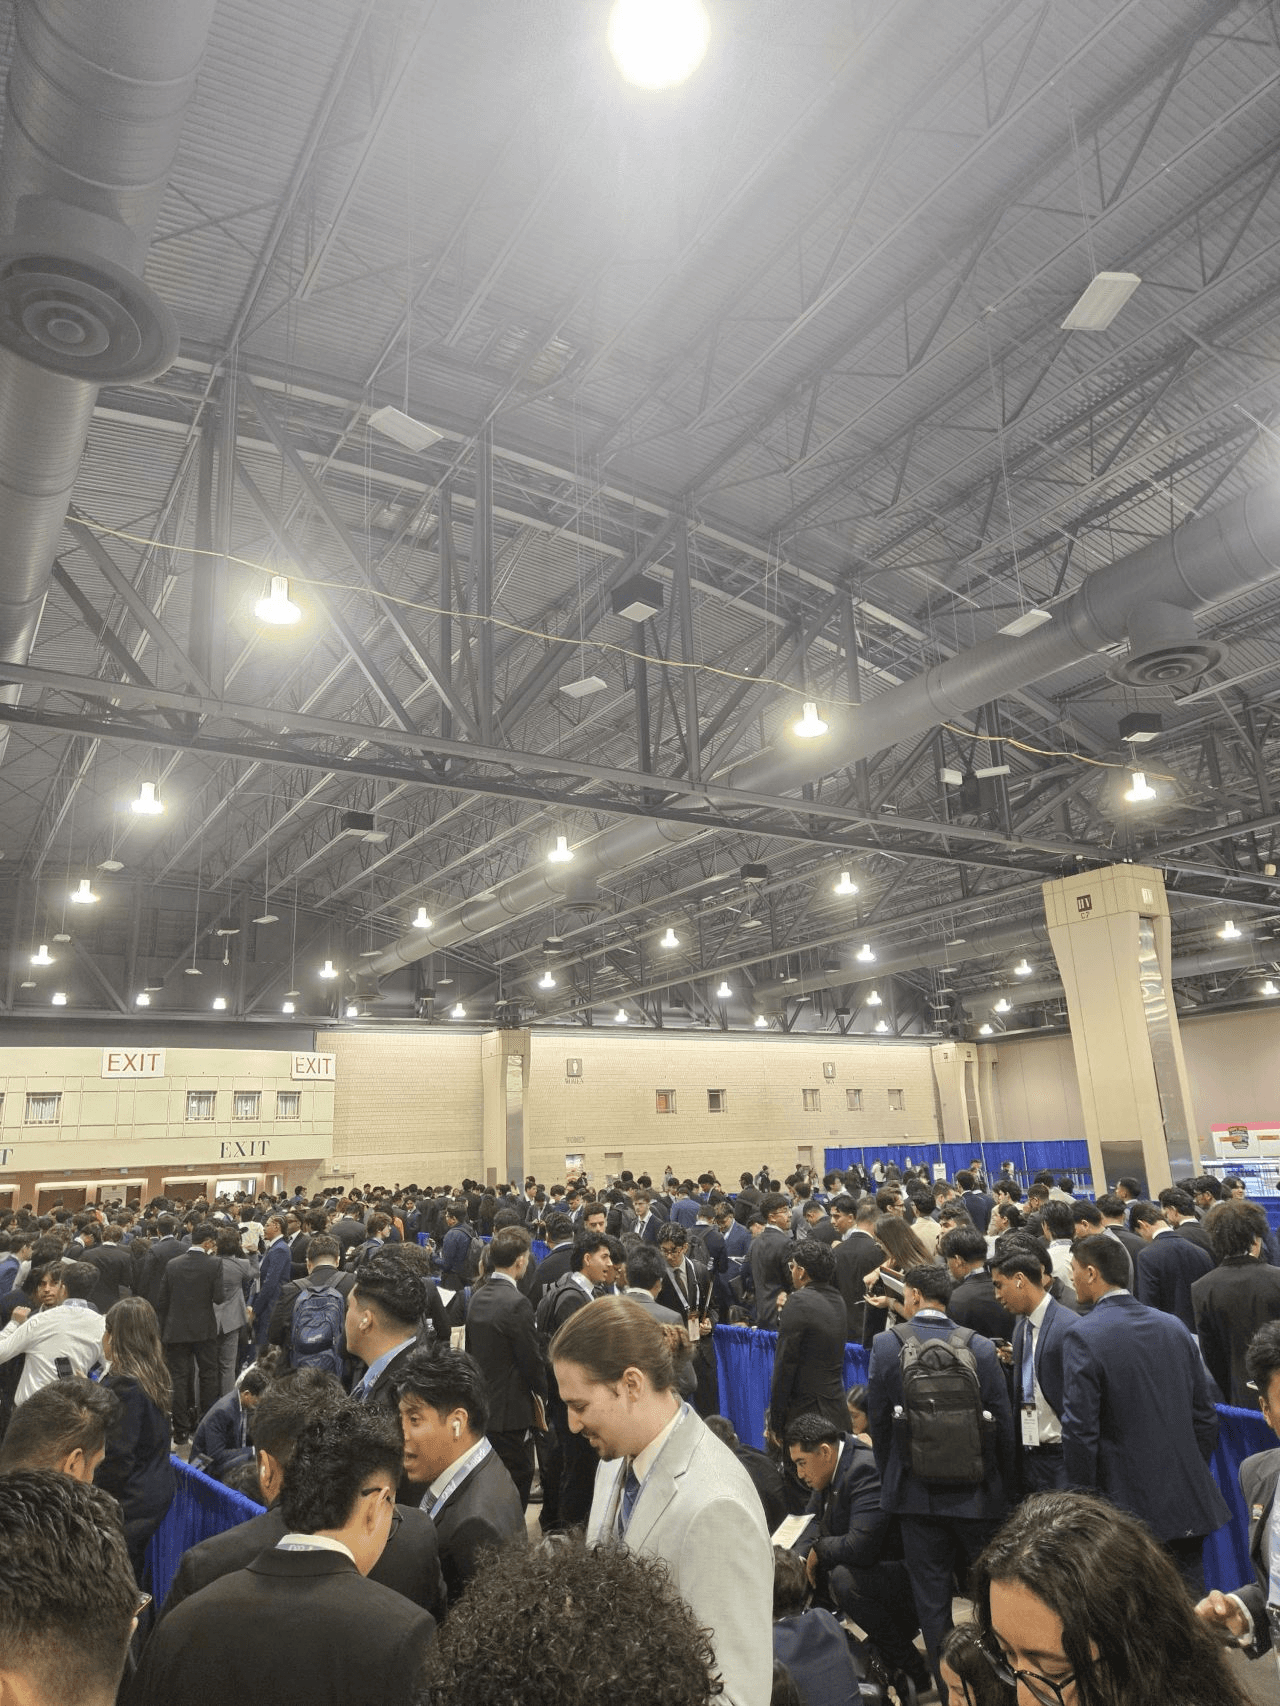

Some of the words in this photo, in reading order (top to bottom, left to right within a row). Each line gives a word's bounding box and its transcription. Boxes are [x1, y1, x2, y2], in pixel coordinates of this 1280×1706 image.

[107, 1053, 161, 1072] EXIT
[295, 1056, 332, 1075] EXIT
[220, 1140, 271, 1159] EXIT
